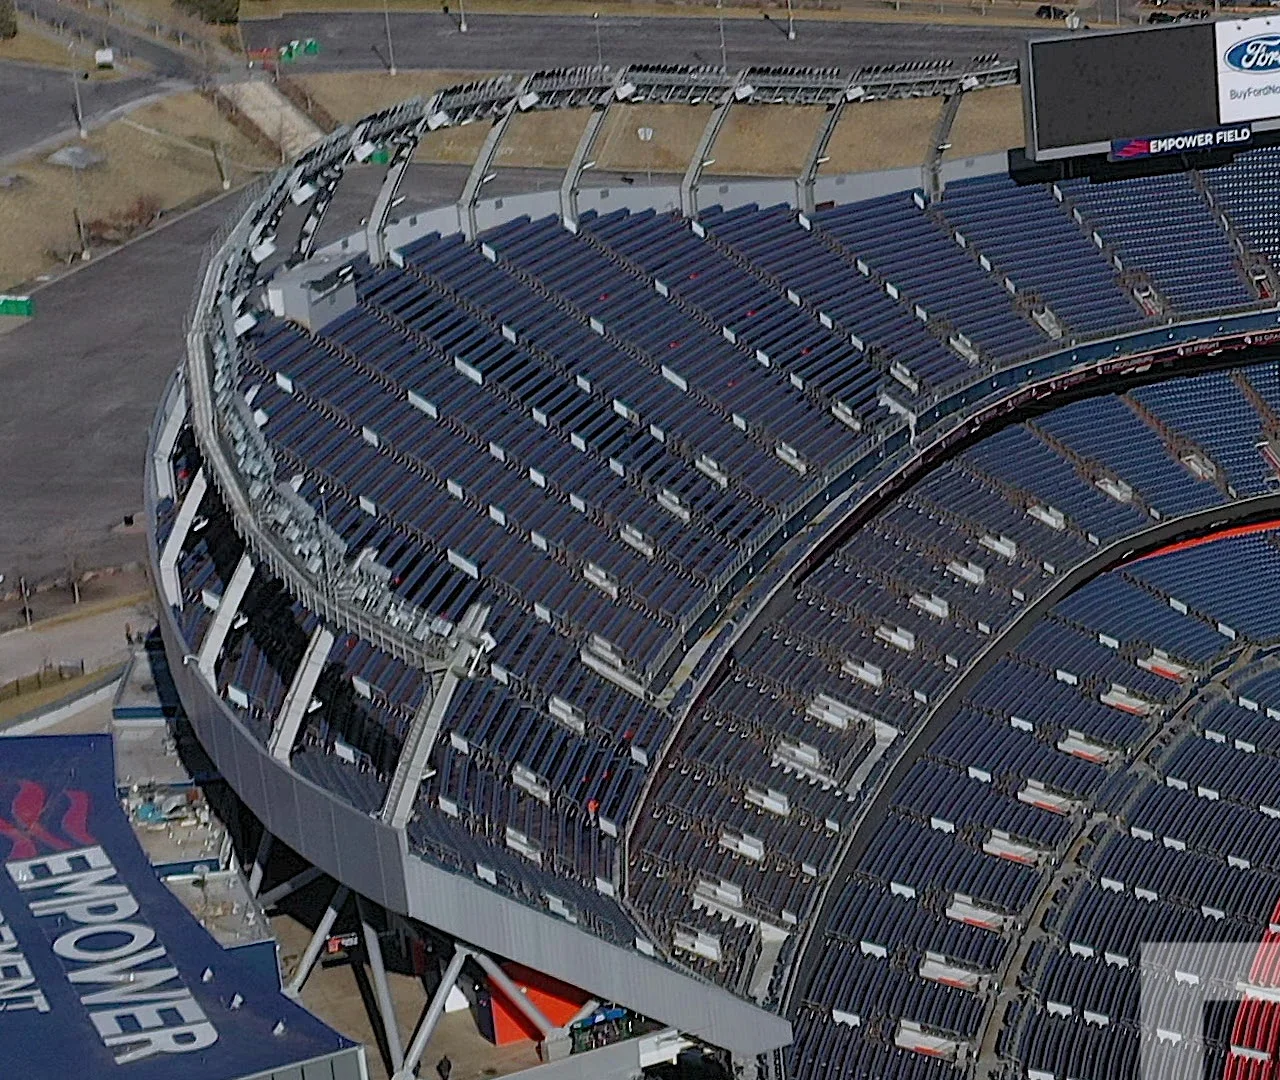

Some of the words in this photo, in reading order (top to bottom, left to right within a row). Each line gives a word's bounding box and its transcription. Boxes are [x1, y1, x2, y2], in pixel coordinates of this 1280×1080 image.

[1150, 131, 1213, 153] EMPOWER
[1216, 127, 1250, 145] FIELD
[5, 845, 218, 1065] EMPOWER
